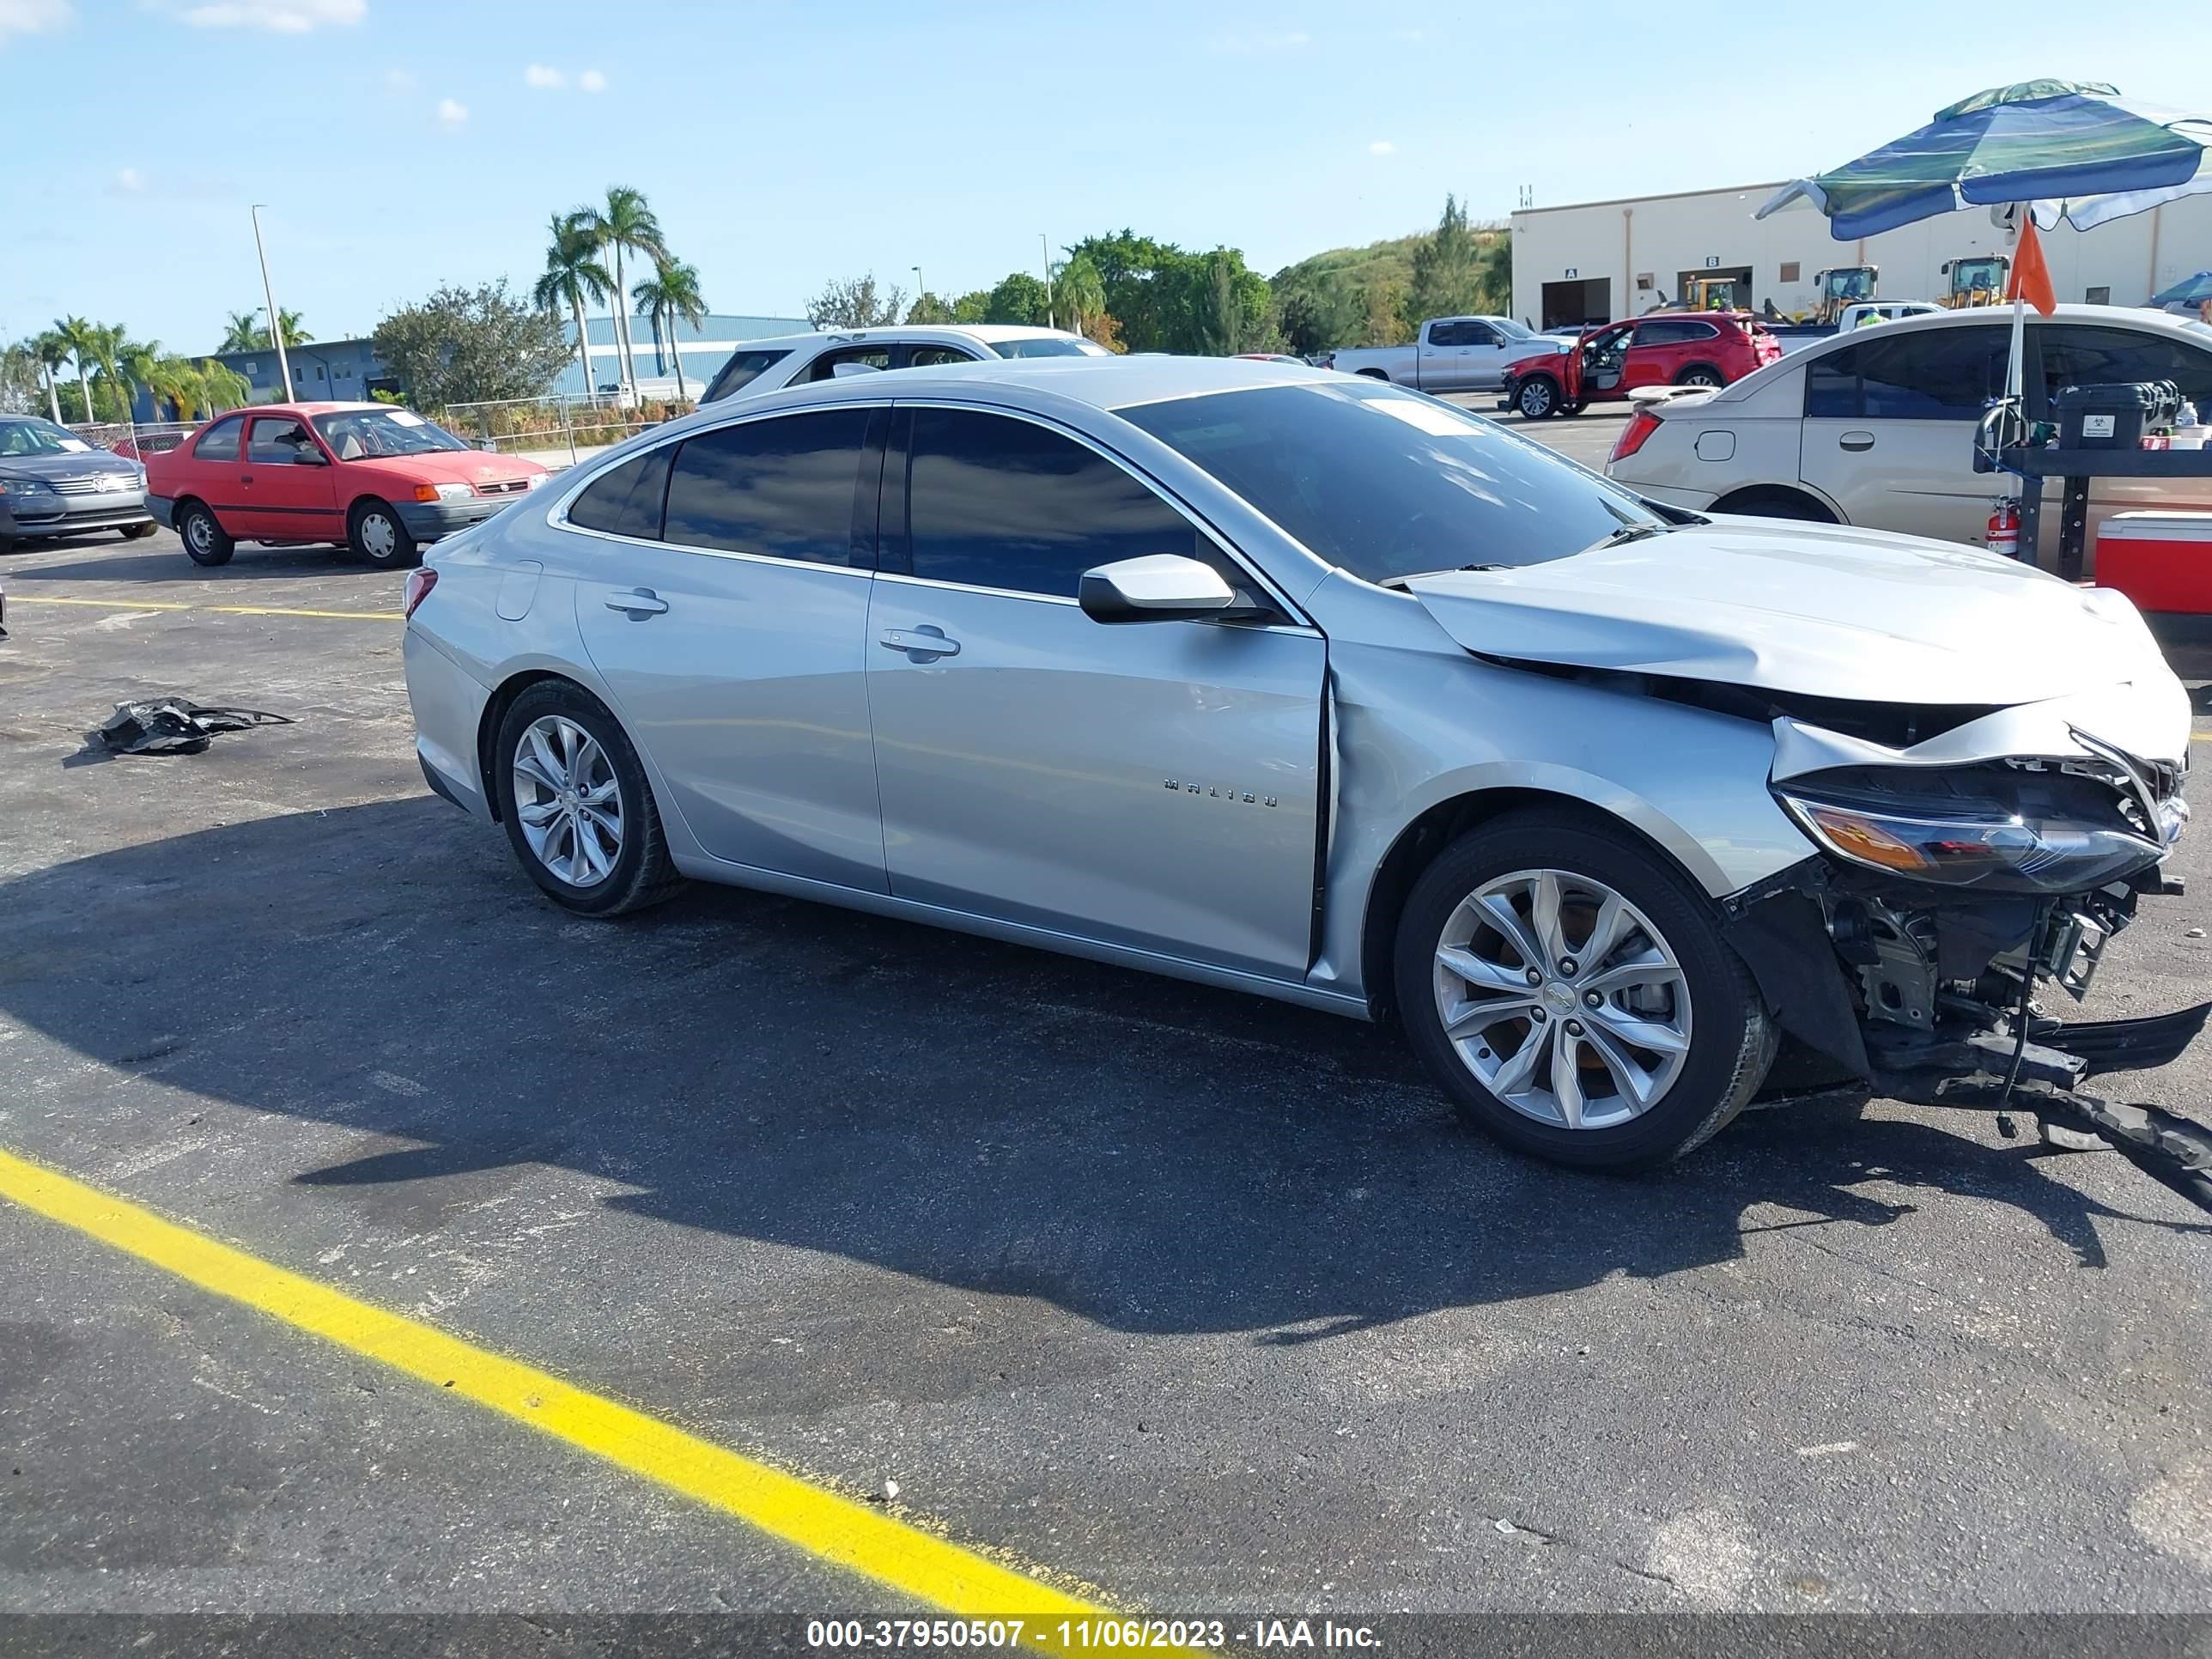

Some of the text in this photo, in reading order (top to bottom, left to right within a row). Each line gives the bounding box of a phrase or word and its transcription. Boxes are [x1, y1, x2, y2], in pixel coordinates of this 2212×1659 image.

[1708, 258, 1717, 266] B
[1566, 269, 1576, 278] A
[1164, 778, 1278, 807] MALIBU
